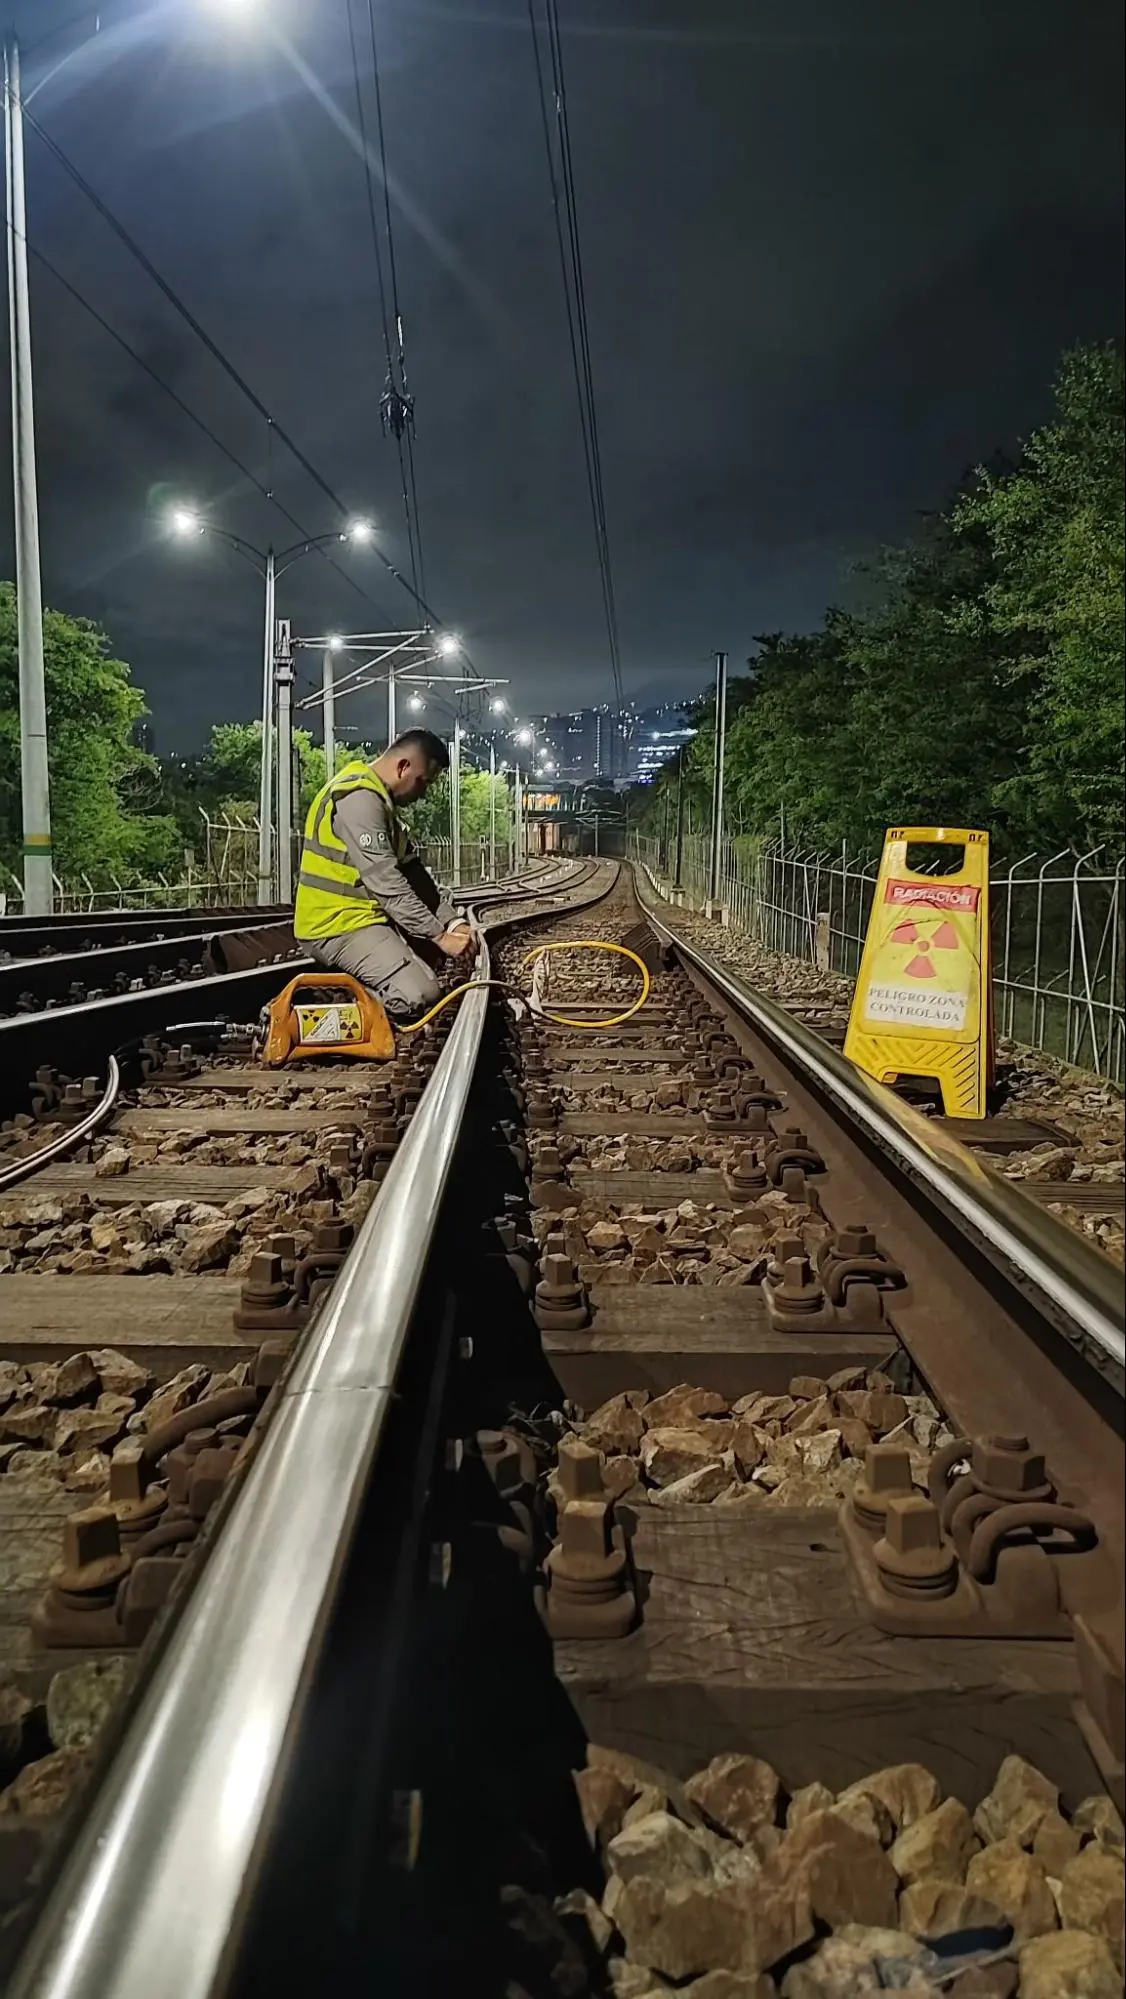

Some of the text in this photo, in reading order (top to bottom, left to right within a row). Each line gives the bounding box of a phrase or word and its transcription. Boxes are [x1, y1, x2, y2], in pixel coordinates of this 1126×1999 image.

[869, 987, 966, 1008] PELIGRO ZONA
[870, 1001, 960, 1022] CONTROLADA
